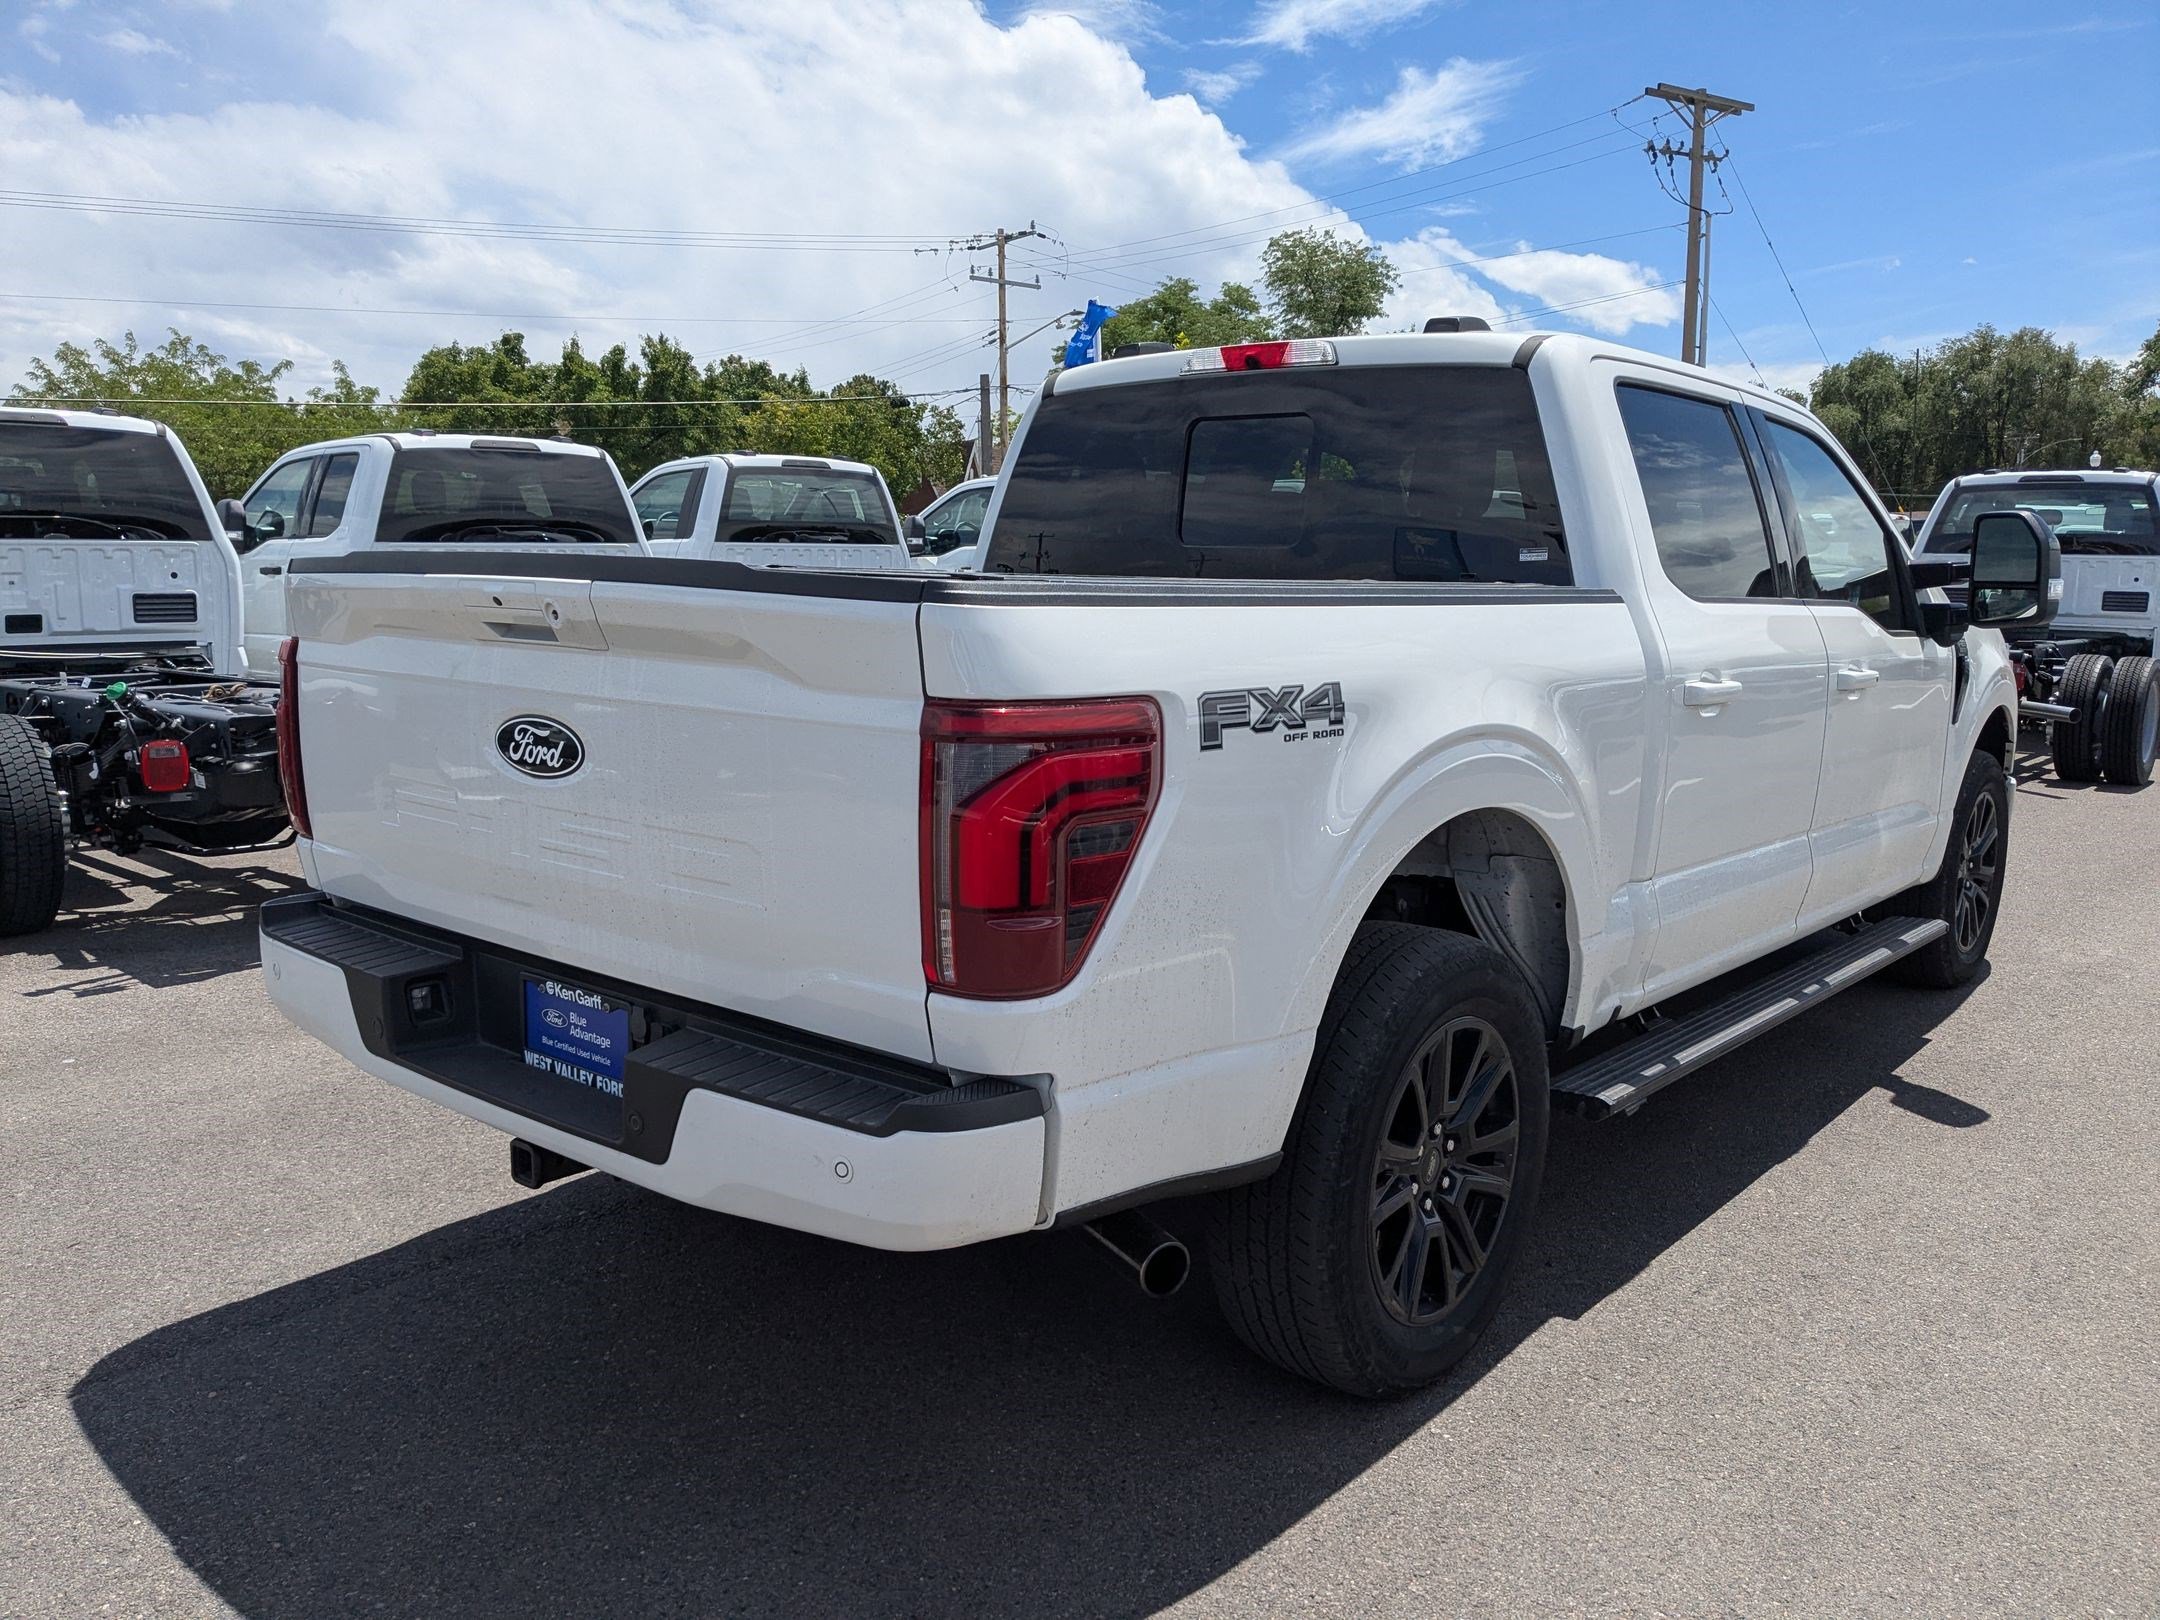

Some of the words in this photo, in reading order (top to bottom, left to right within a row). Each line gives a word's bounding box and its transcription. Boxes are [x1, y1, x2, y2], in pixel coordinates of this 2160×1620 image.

[1198, 681, 1345, 750] FX4
[509, 724, 564, 768] Ford
[1284, 732, 1308, 743] OFF
[1313, 728, 1344, 740] ROAD
[546, 1010, 563, 1026] Ford
[569, 1011, 587, 1027] Blue
[542, 1035, 554, 1047] Blue
[554, 1040, 576, 1054] Certified
[576, 1047, 591, 1059] Used
[591, 1052, 611, 1066] Vehicle
[569, 1025, 611, 1049] Advantage
[524, 1050, 552, 1071] WEST
[554, 1061, 594, 1087] VALLEY
